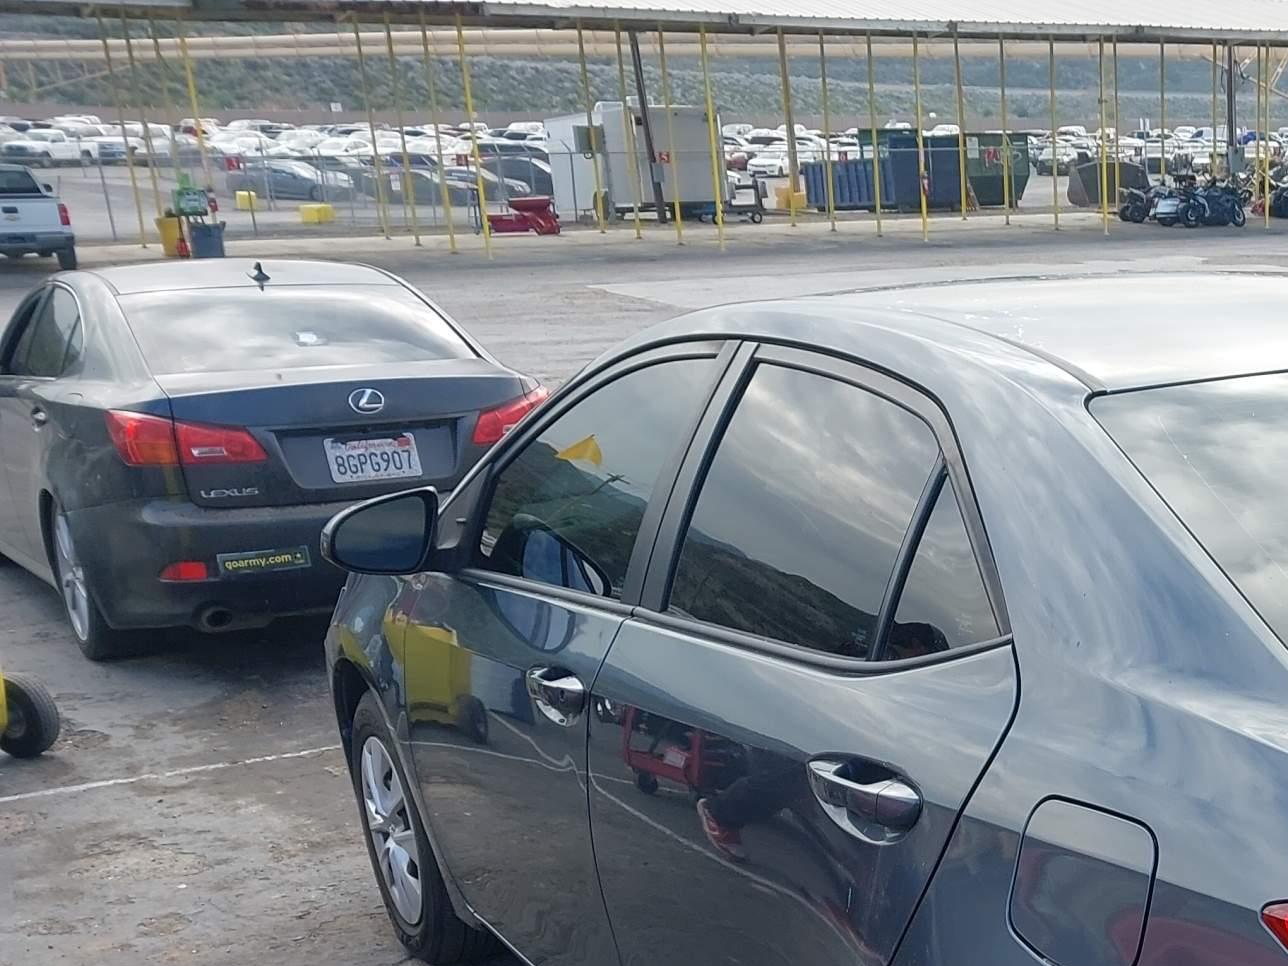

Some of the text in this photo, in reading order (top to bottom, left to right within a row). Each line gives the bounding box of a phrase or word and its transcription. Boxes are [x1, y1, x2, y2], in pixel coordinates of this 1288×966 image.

[335, 449, 412, 475] 8GPG907
[200, 487, 259, 498] LEXUS
[224, 553, 292, 570] goarmy.com
